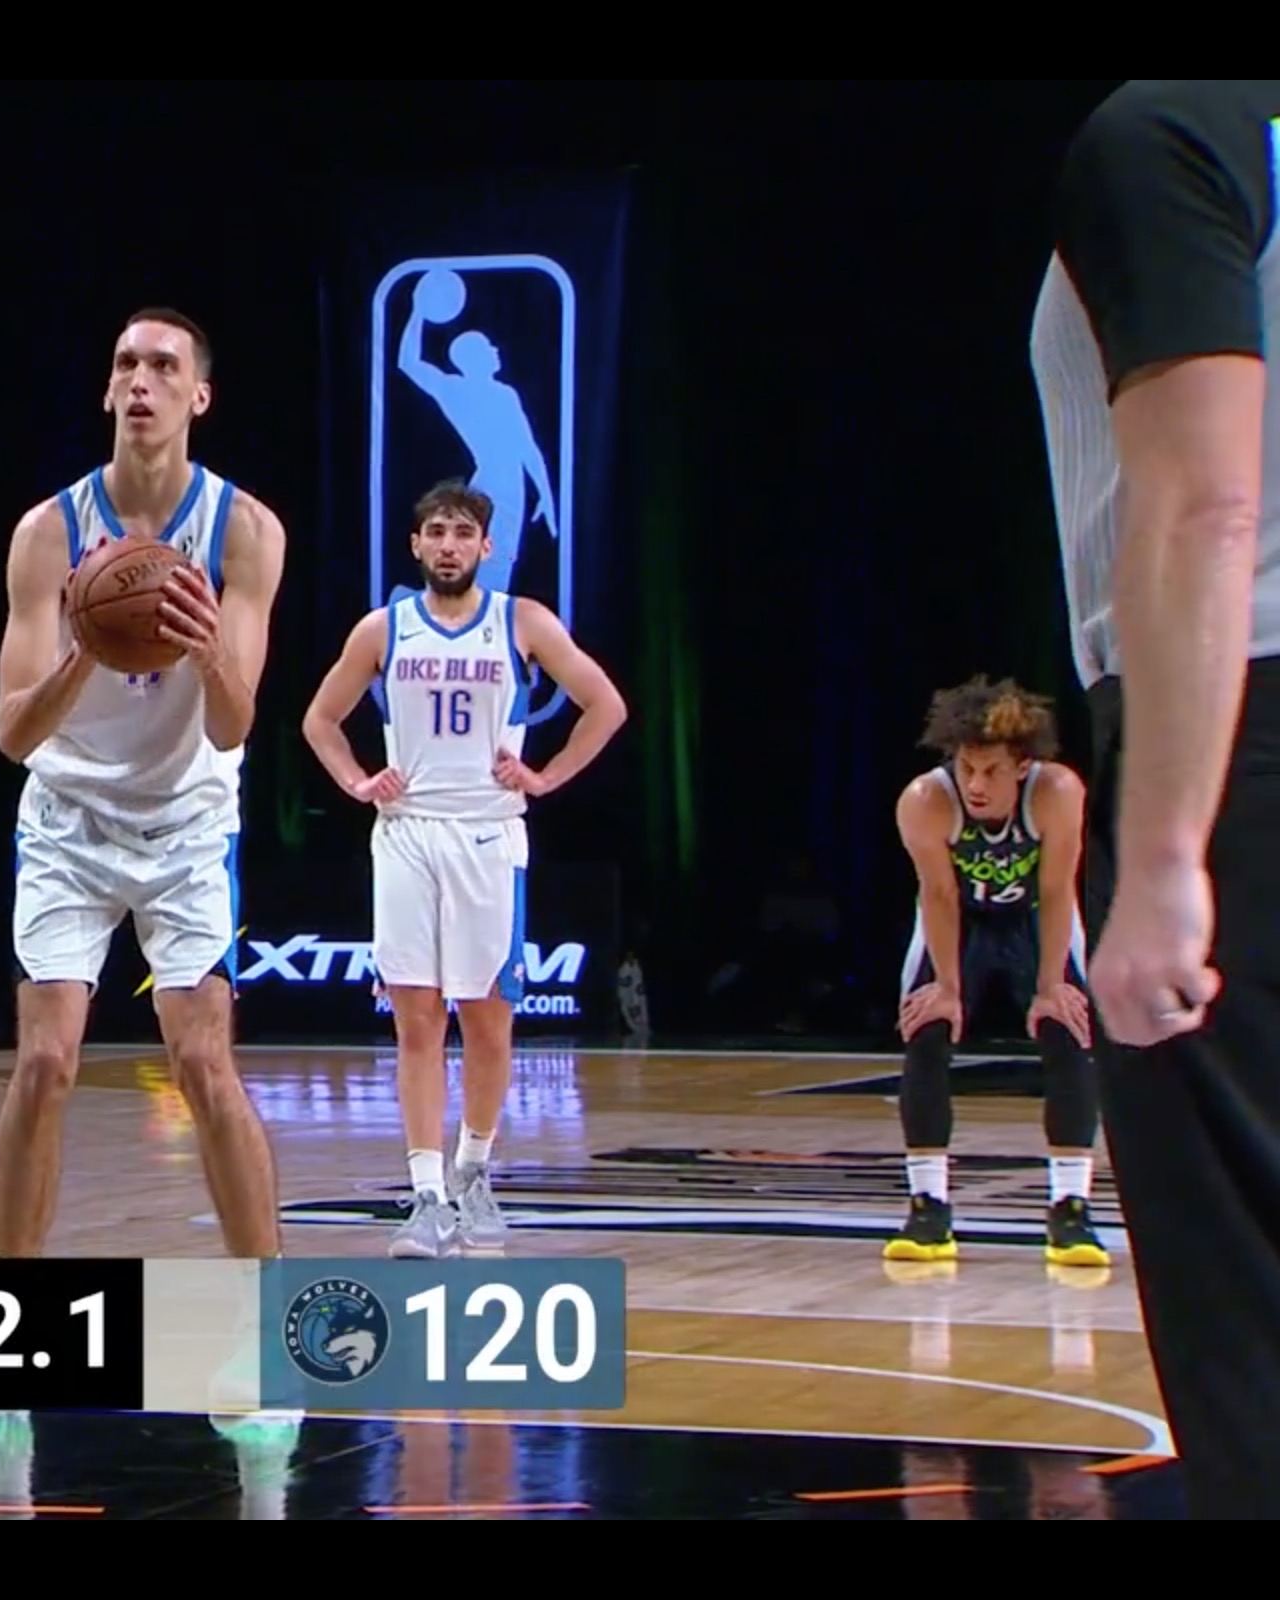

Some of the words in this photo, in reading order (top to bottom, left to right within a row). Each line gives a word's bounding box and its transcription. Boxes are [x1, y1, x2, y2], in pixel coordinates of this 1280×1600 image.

[396, 658, 441, 682] OKC
[445, 658, 504, 685] BLUE
[428, 687, 472, 736] 16
